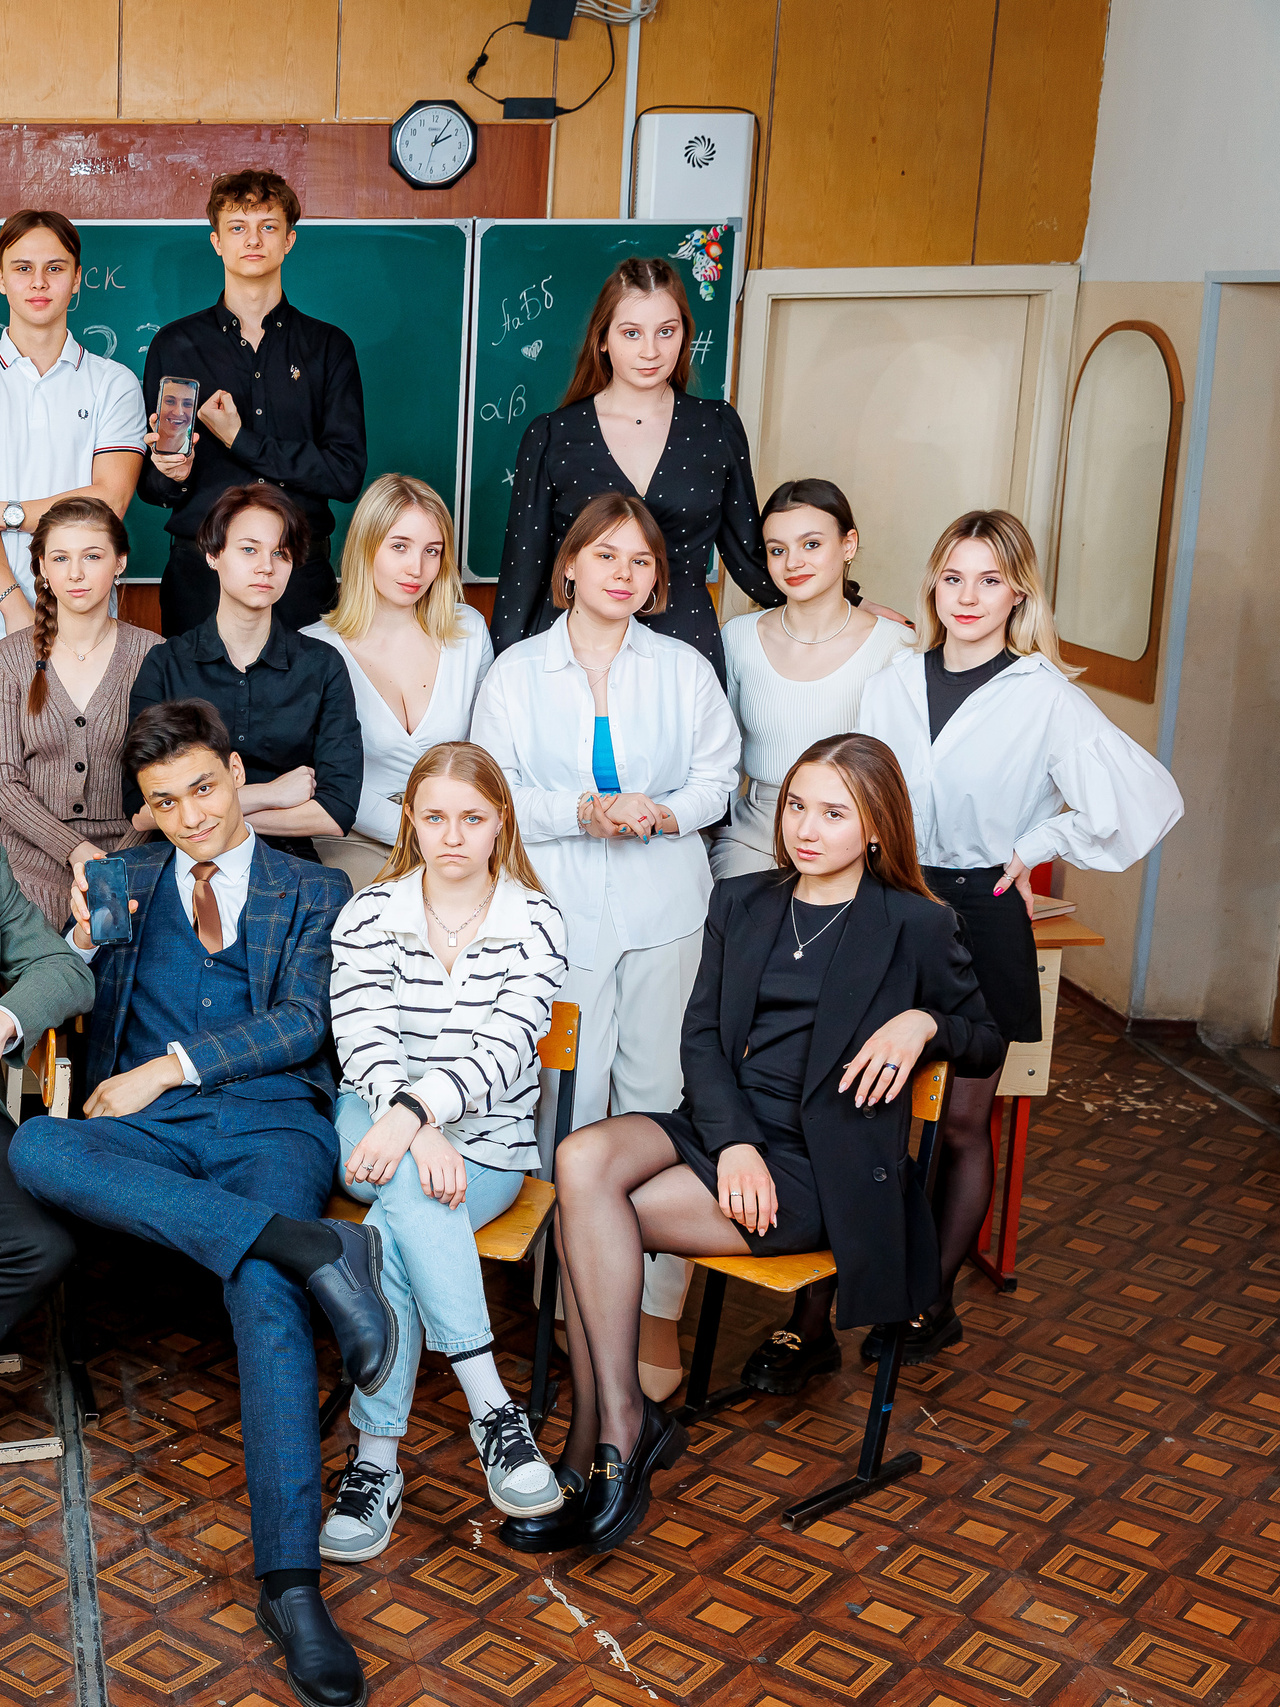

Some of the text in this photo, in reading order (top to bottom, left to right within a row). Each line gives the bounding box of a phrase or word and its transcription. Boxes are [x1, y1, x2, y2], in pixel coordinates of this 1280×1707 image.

[432, 114, 440, 123] 12
[419, 119, 426, 128] 11
[410, 128, 417, 137] 10
